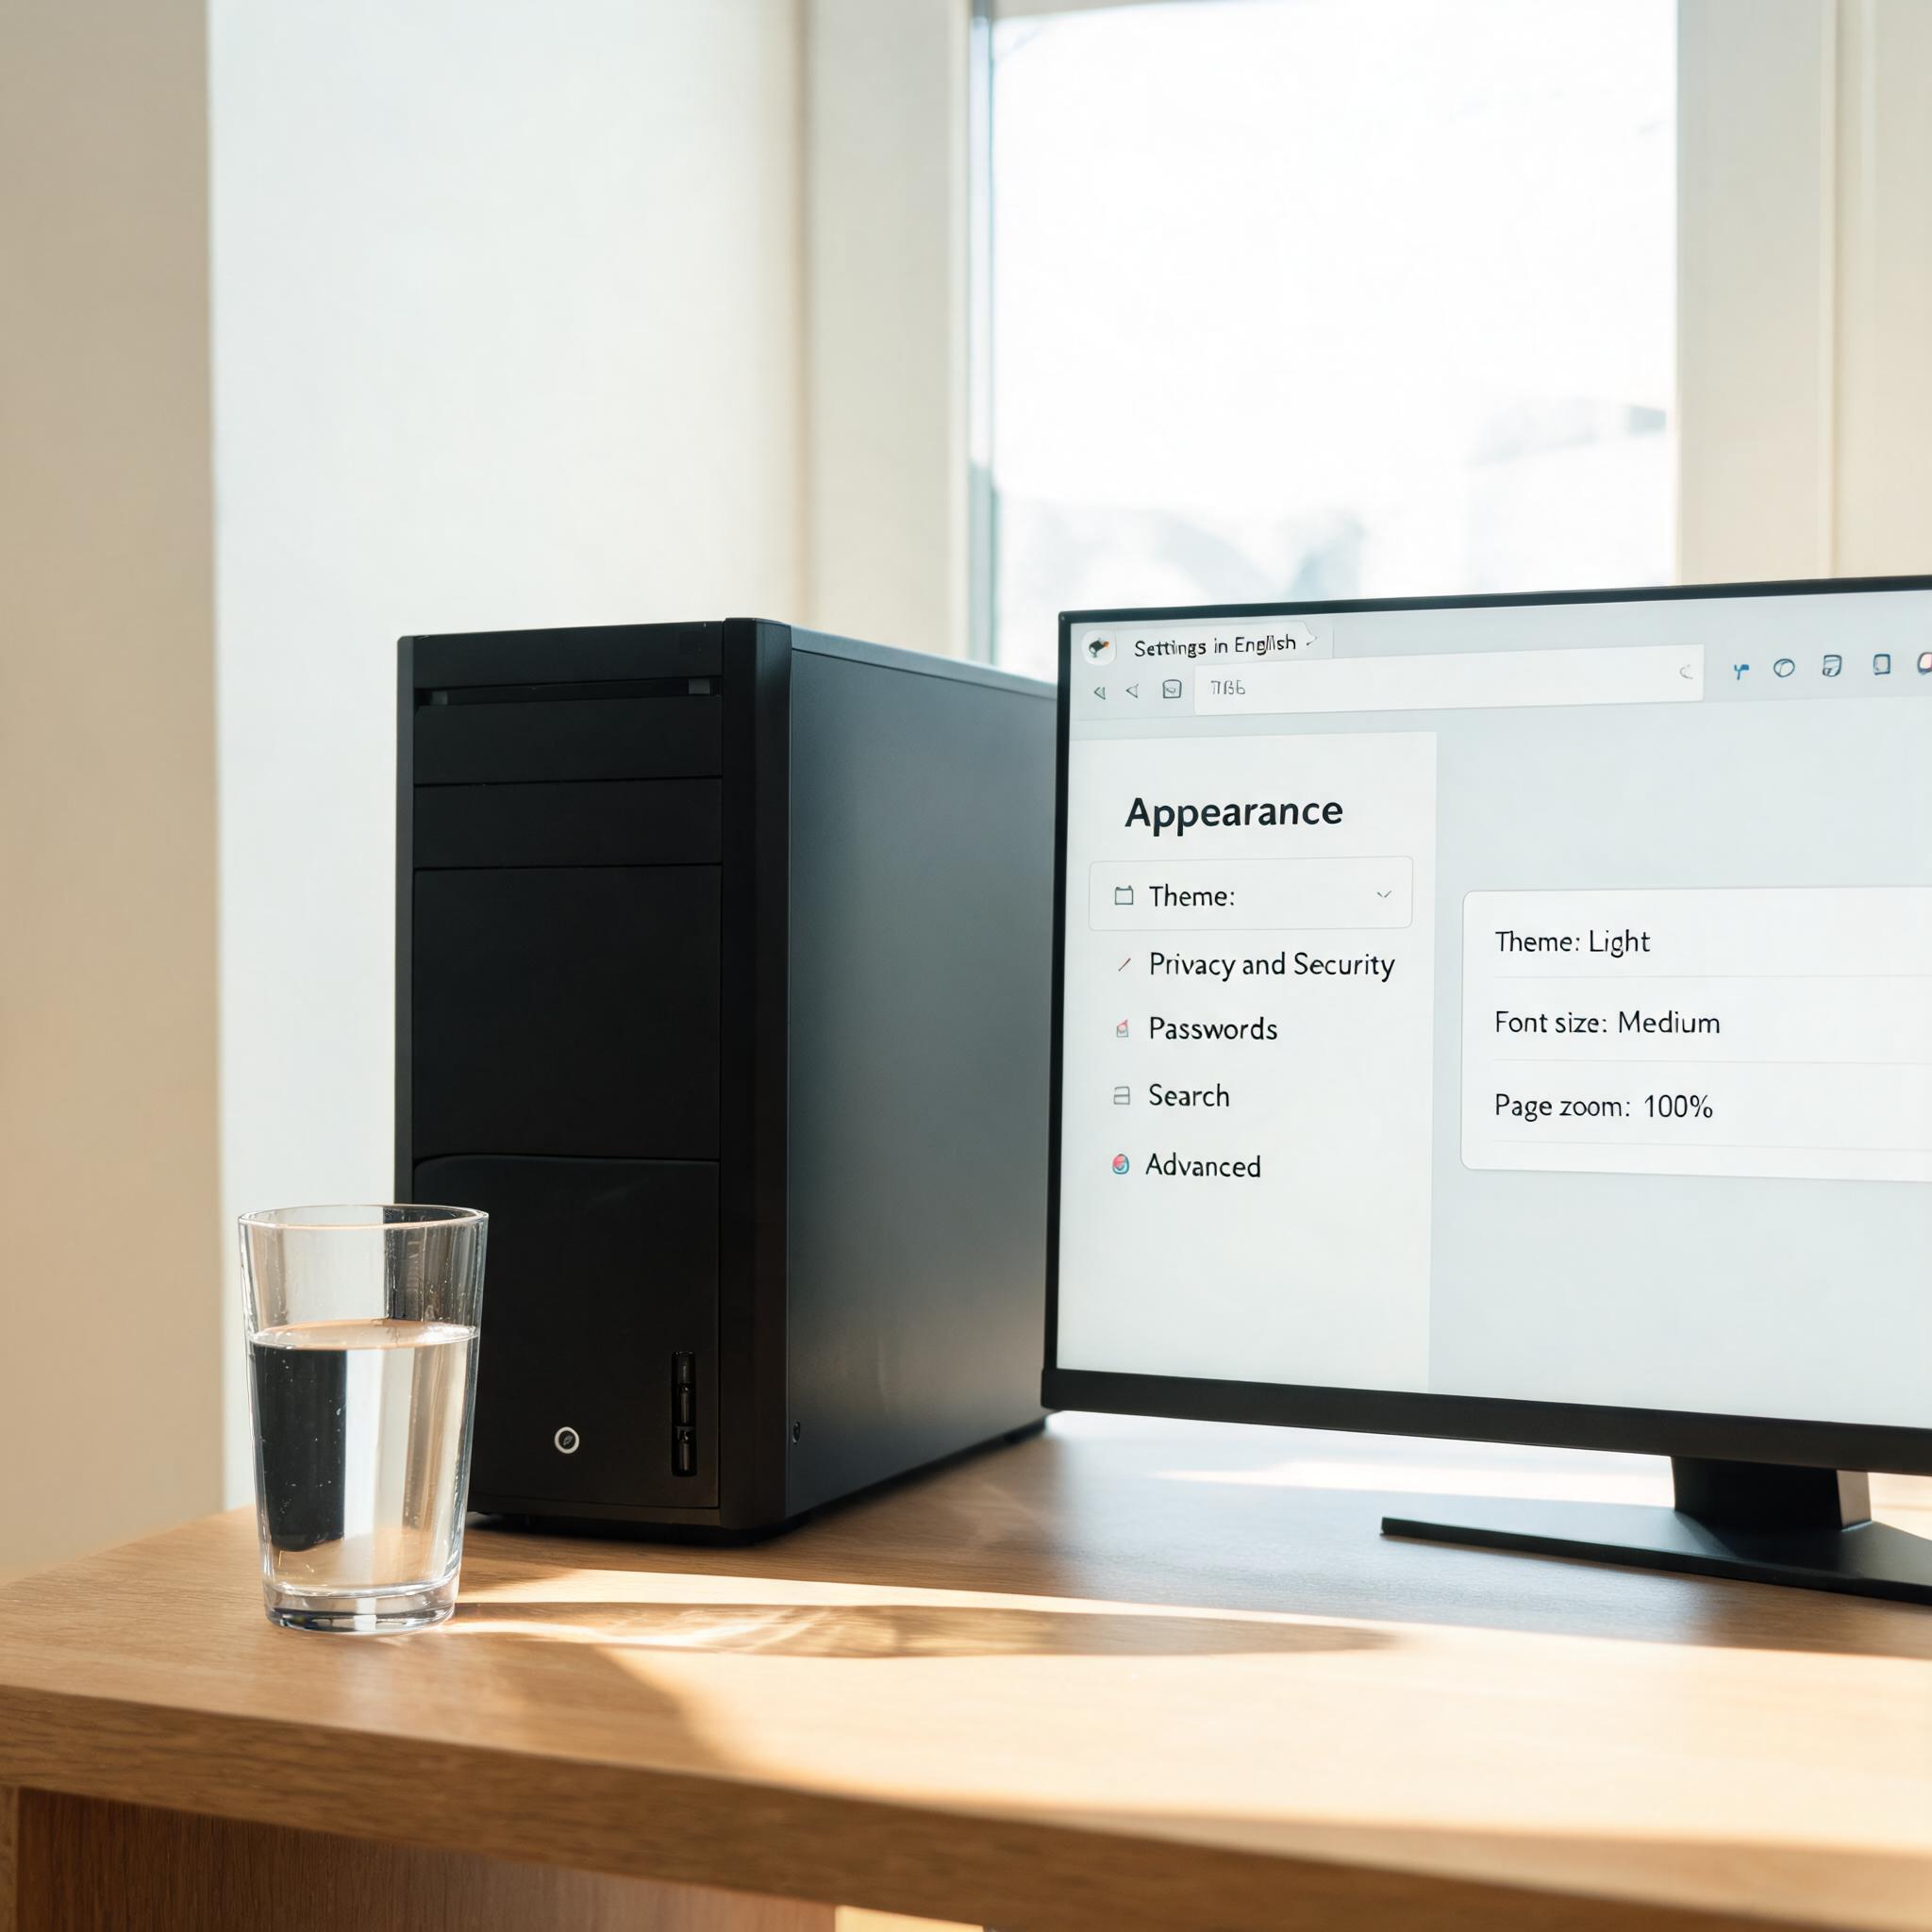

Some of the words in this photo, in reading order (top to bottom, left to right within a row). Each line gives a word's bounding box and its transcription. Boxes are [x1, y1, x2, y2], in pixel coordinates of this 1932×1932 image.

[1134, 639, 1208, 659] Settings
[1213, 637, 1229, 655] in
[1124, 796, 1343, 838] Appearance
[1148, 882, 1235, 908] Theme:
[1494, 929, 1581, 953] Theme:
[1589, 928, 1652, 959] Light
[1150, 951, 1238, 983] Privacy
[1241, 950, 1286, 975] and
[1293, 951, 1396, 984] Security
[1149, 1015, 1278, 1041] Passwords
[1495, 1009, 1549, 1034] Font
[1555, 1010, 1607, 1034] size:
[1618, 1008, 1721, 1035] Medium
[1148, 1082, 1230, 1108] Search
[1495, 1092, 1553, 1123] Page
[1557, 1100, 1631, 1118] zoom:
[1644, 1093, 1714, 1119] 100%
[1144, 1151, 1261, 1178] Advanced
